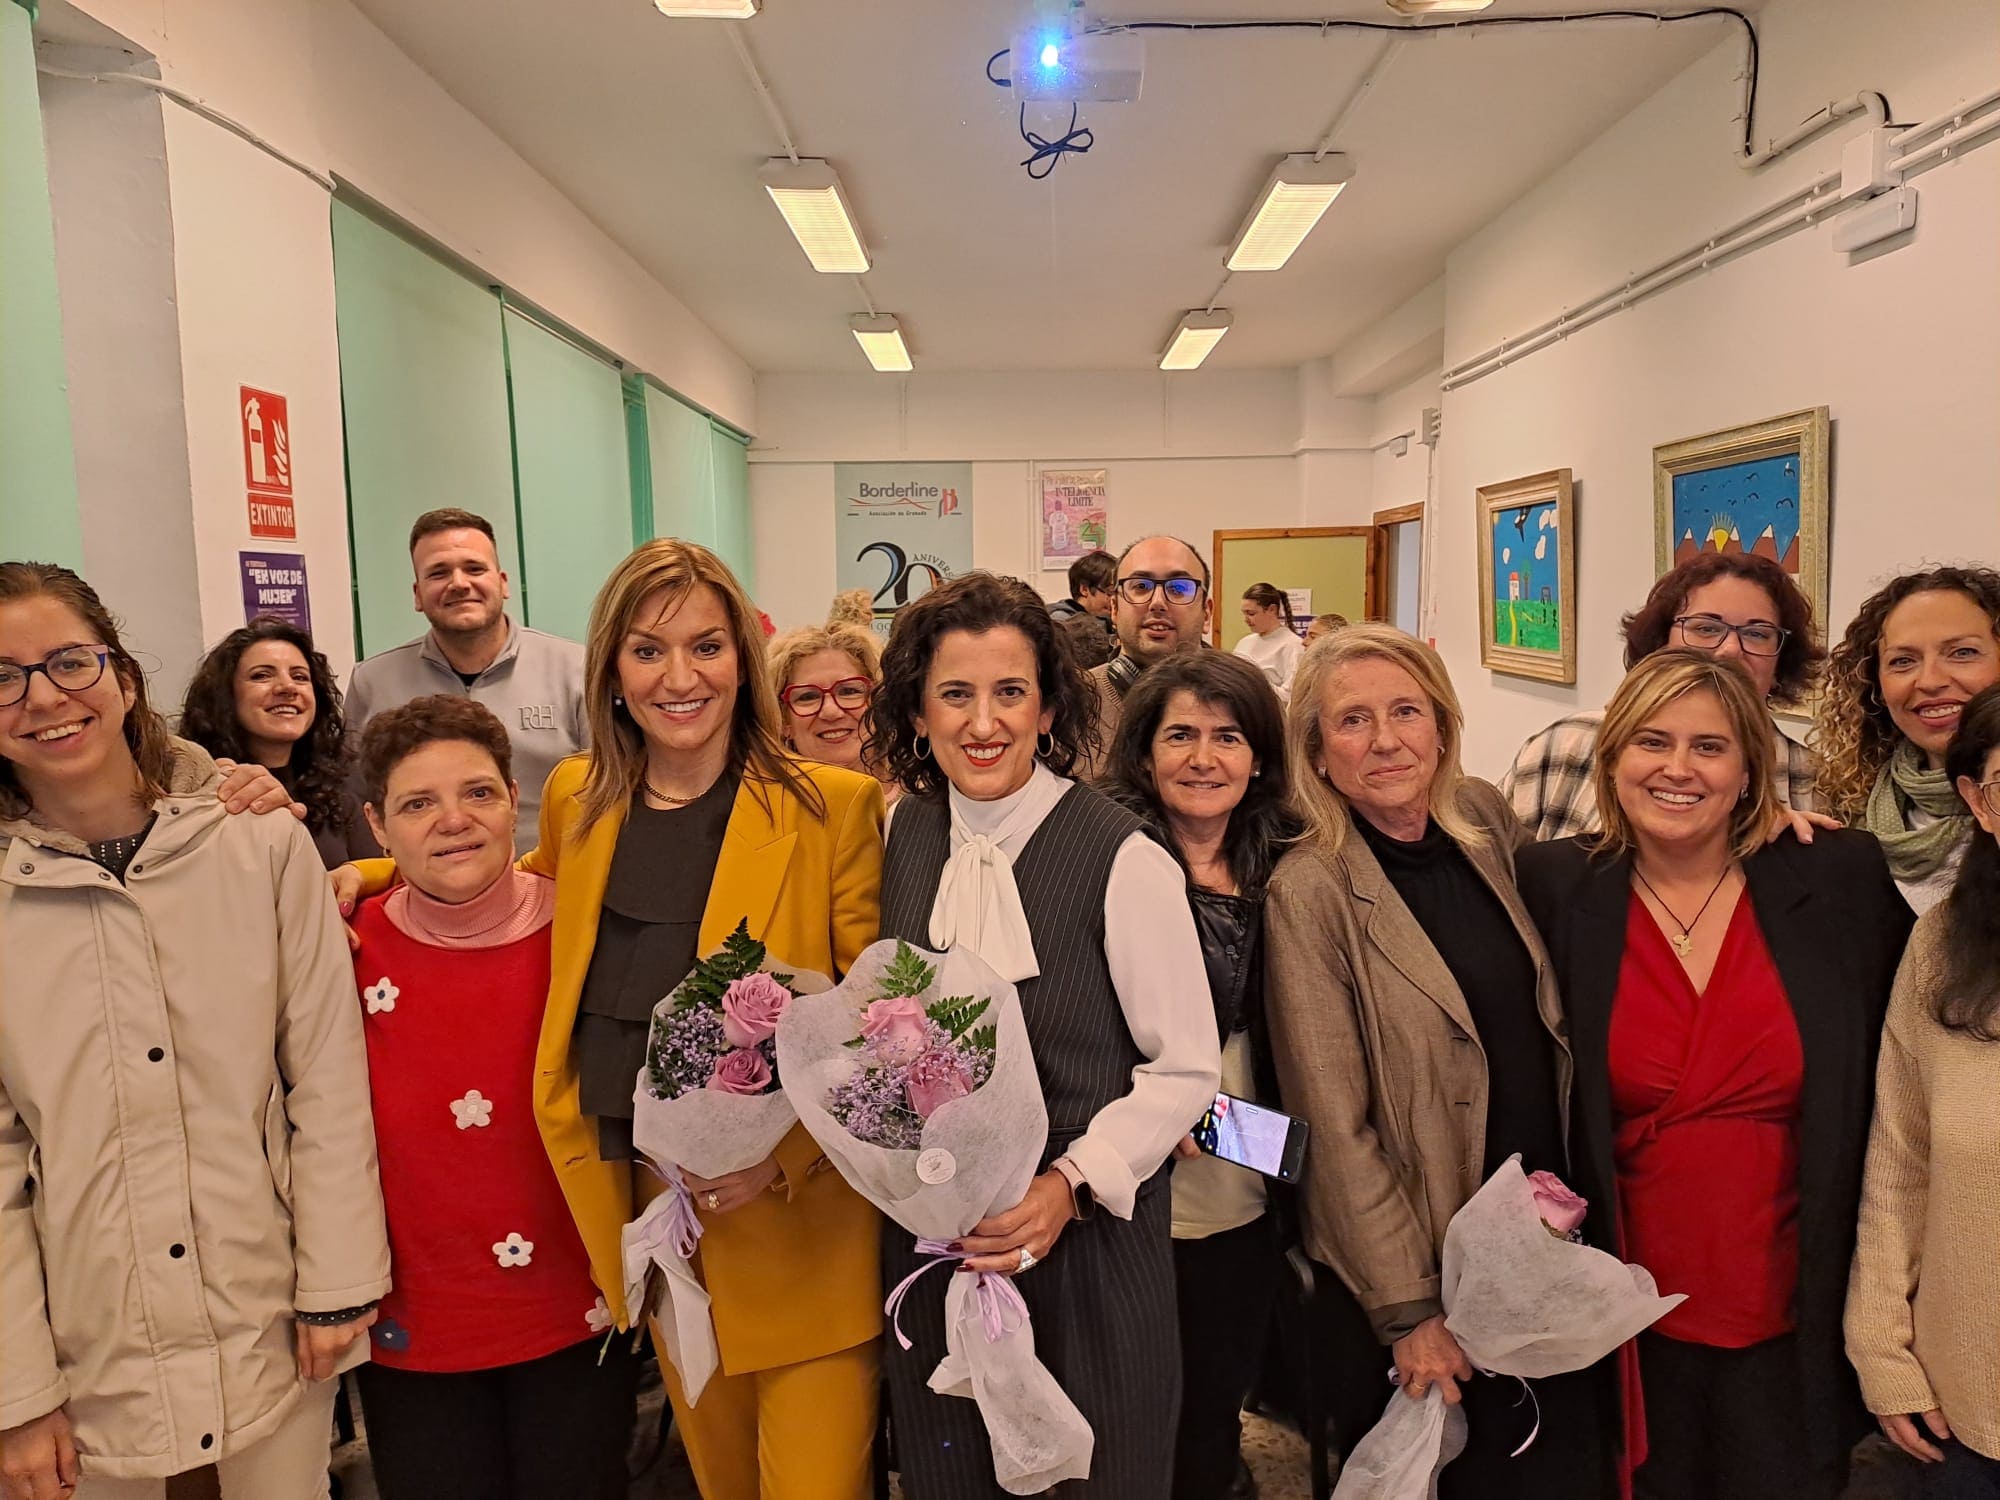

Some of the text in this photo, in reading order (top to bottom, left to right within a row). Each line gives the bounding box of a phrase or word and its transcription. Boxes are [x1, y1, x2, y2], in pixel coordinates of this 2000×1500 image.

[859, 482, 938, 498] Borderline
[250, 502, 294, 528] EXTINTOR
[269, 569, 290, 585] VOZ
[290, 570, 303, 586] DE
